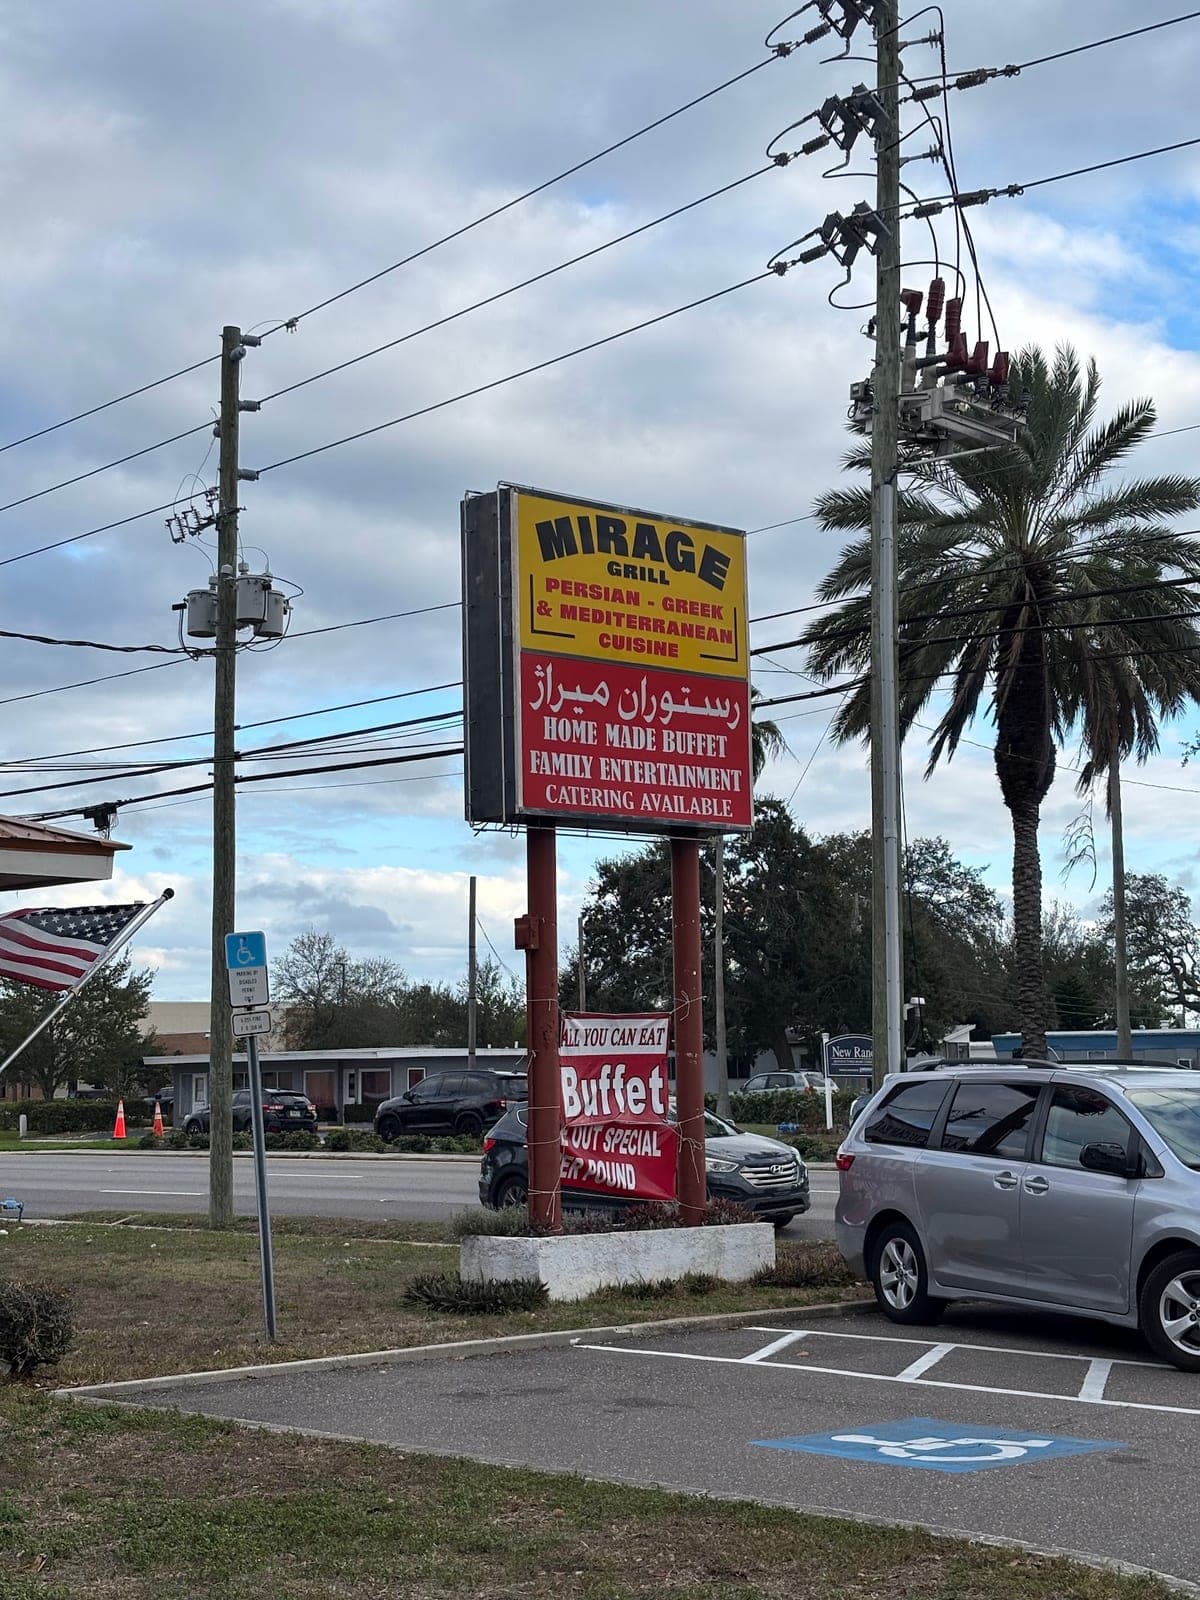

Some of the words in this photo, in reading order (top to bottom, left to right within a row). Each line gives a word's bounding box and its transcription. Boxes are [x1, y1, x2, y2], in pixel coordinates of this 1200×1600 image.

[535, 515, 731, 591] MIRAGE
[607, 561, 670, 585] GRILL
[545, 577, 640, 606] PERSIAN
[662, 596, 724, 620] GREEK
[536, 600, 553, 618] &
[560, 604, 733, 644] MEDITERRANEAN
[598, 633, 679, 658] CUISINE
[618, 675, 740, 730] رستوران
[543, 716, 598, 745] HOME
[605, 723, 656, 750] MADE
[662, 728, 727, 758] BUFFET
[529, 750, 593, 779] FAMILY
[599, 757, 742, 792] ENTERTAINMENT
[545, 784, 635, 810] CATERING
[640, 792, 734, 818] AVAILABLE
[560, 1028, 580, 1047] ALL
[583, 1028, 609, 1047] YOU
[611, 1028, 637, 1047] CAN
[638, 1028, 666, 1046] EAT
[832, 1045, 852, 1058] New
[560, 1064, 665, 1118] Buffet
[571, 1126, 604, 1151] OUT
[602, 1127, 662, 1157] SPECIAL
[583, 1159, 636, 1190] POUND
